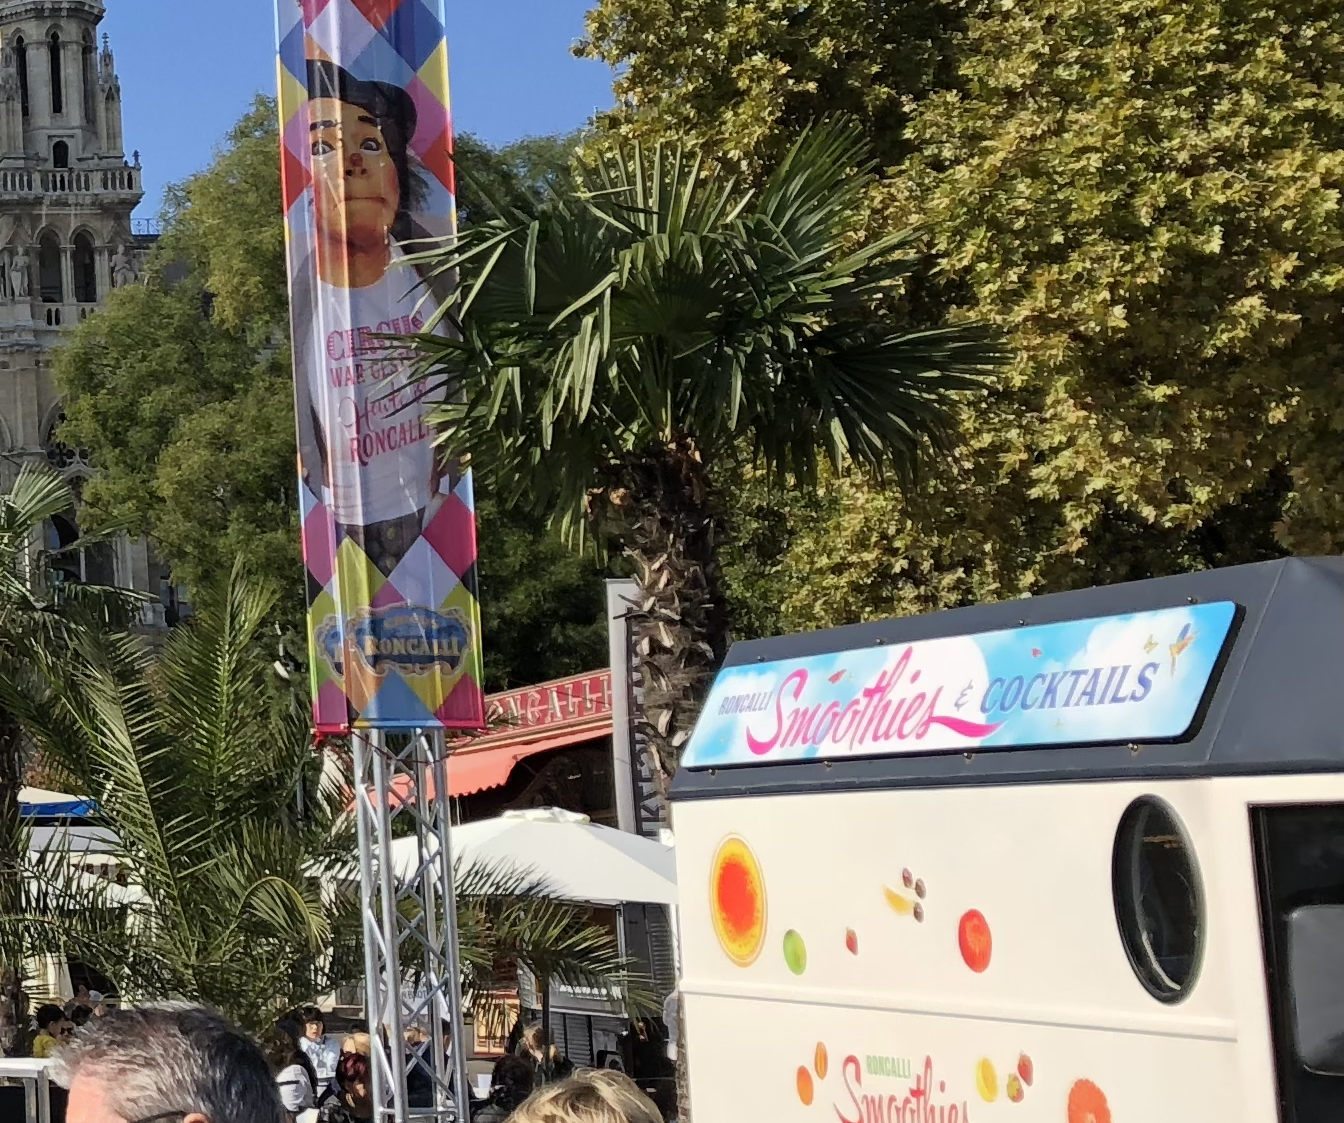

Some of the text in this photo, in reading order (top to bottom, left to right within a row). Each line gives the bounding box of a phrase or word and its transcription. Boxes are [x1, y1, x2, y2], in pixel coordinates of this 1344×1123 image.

[330, 363, 367, 388] WAR
[365, 634, 461, 657] RONCALLI
[718, 690, 774, 716] RONCALLI
[746, 646, 1007, 756] Smoothies
[979, 661, 1161, 715] COCKTAILS
[865, 1054, 912, 1080] RONCALLI
